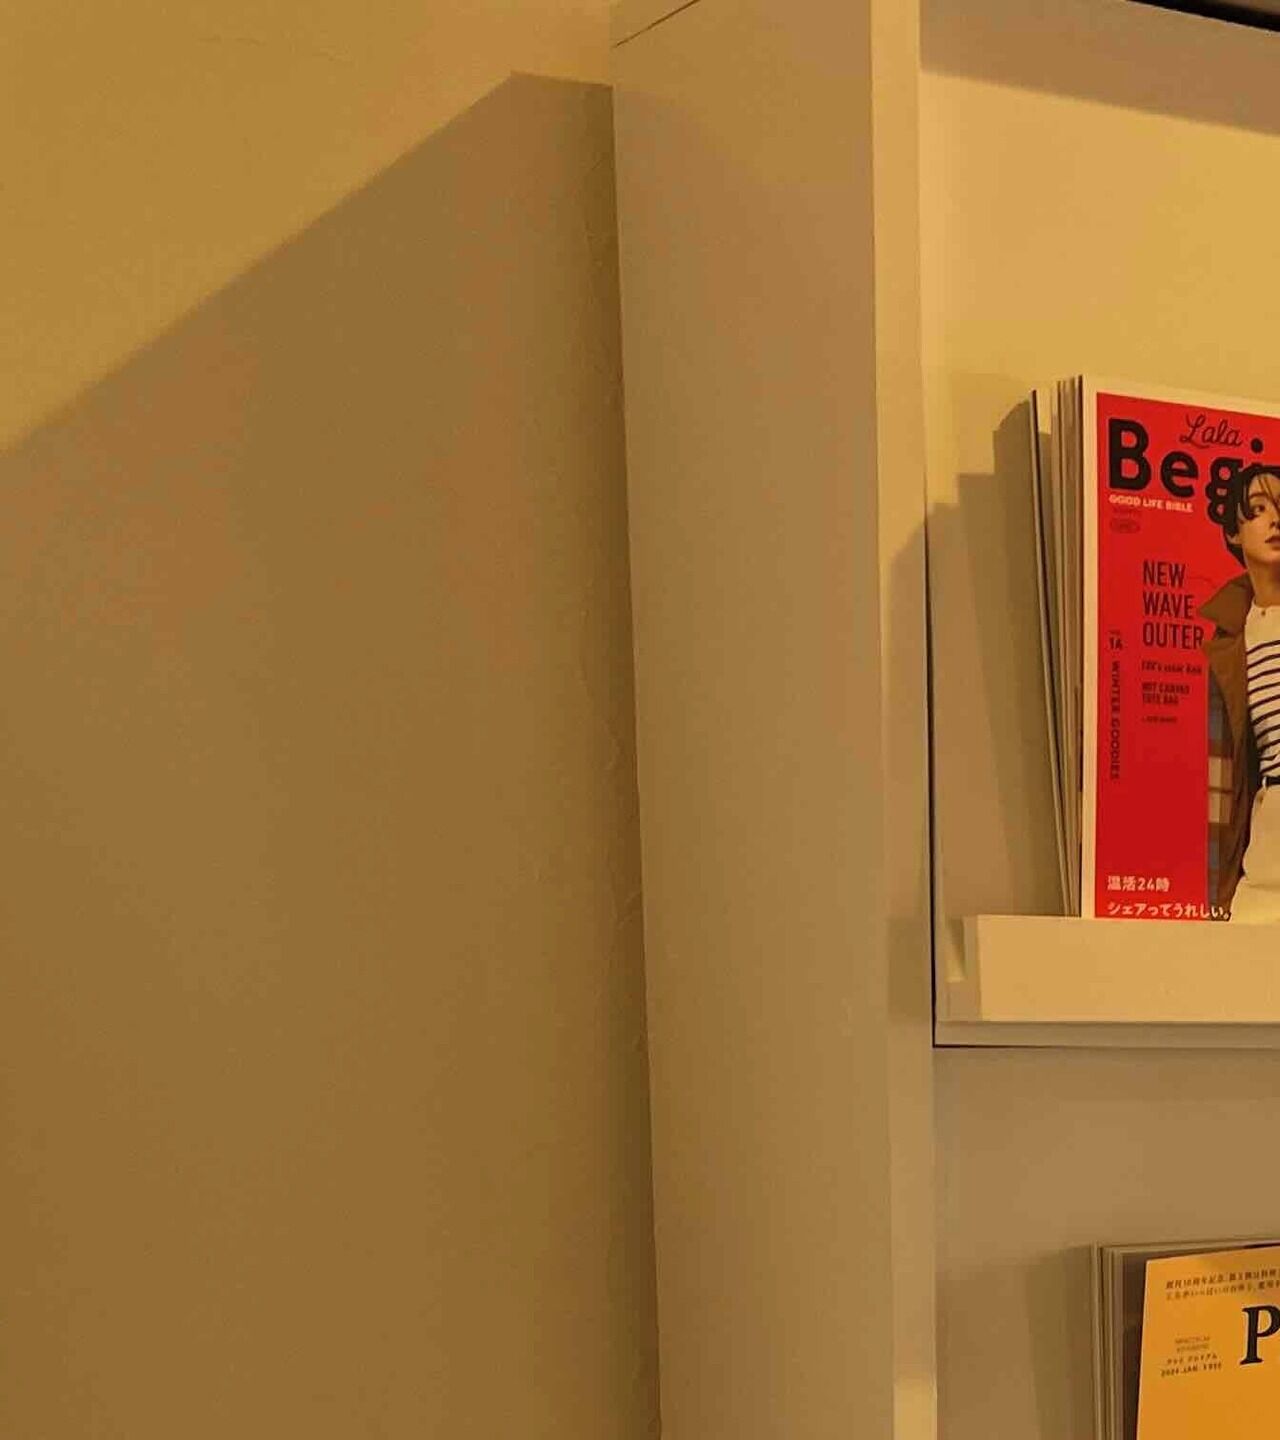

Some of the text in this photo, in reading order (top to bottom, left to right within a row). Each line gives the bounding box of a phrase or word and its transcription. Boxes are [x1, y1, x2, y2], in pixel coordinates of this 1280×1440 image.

[1180, 413, 1243, 449] Lala
[1109, 494, 1193, 513] GOOD LIFE BIBLE
[1143, 560, 1185, 588] NEW
[1143, 592, 1194, 619] WAVE
[1142, 622, 1205, 650] OUTER
[1107, 901, 1231, 919] シェアってうれしい。
